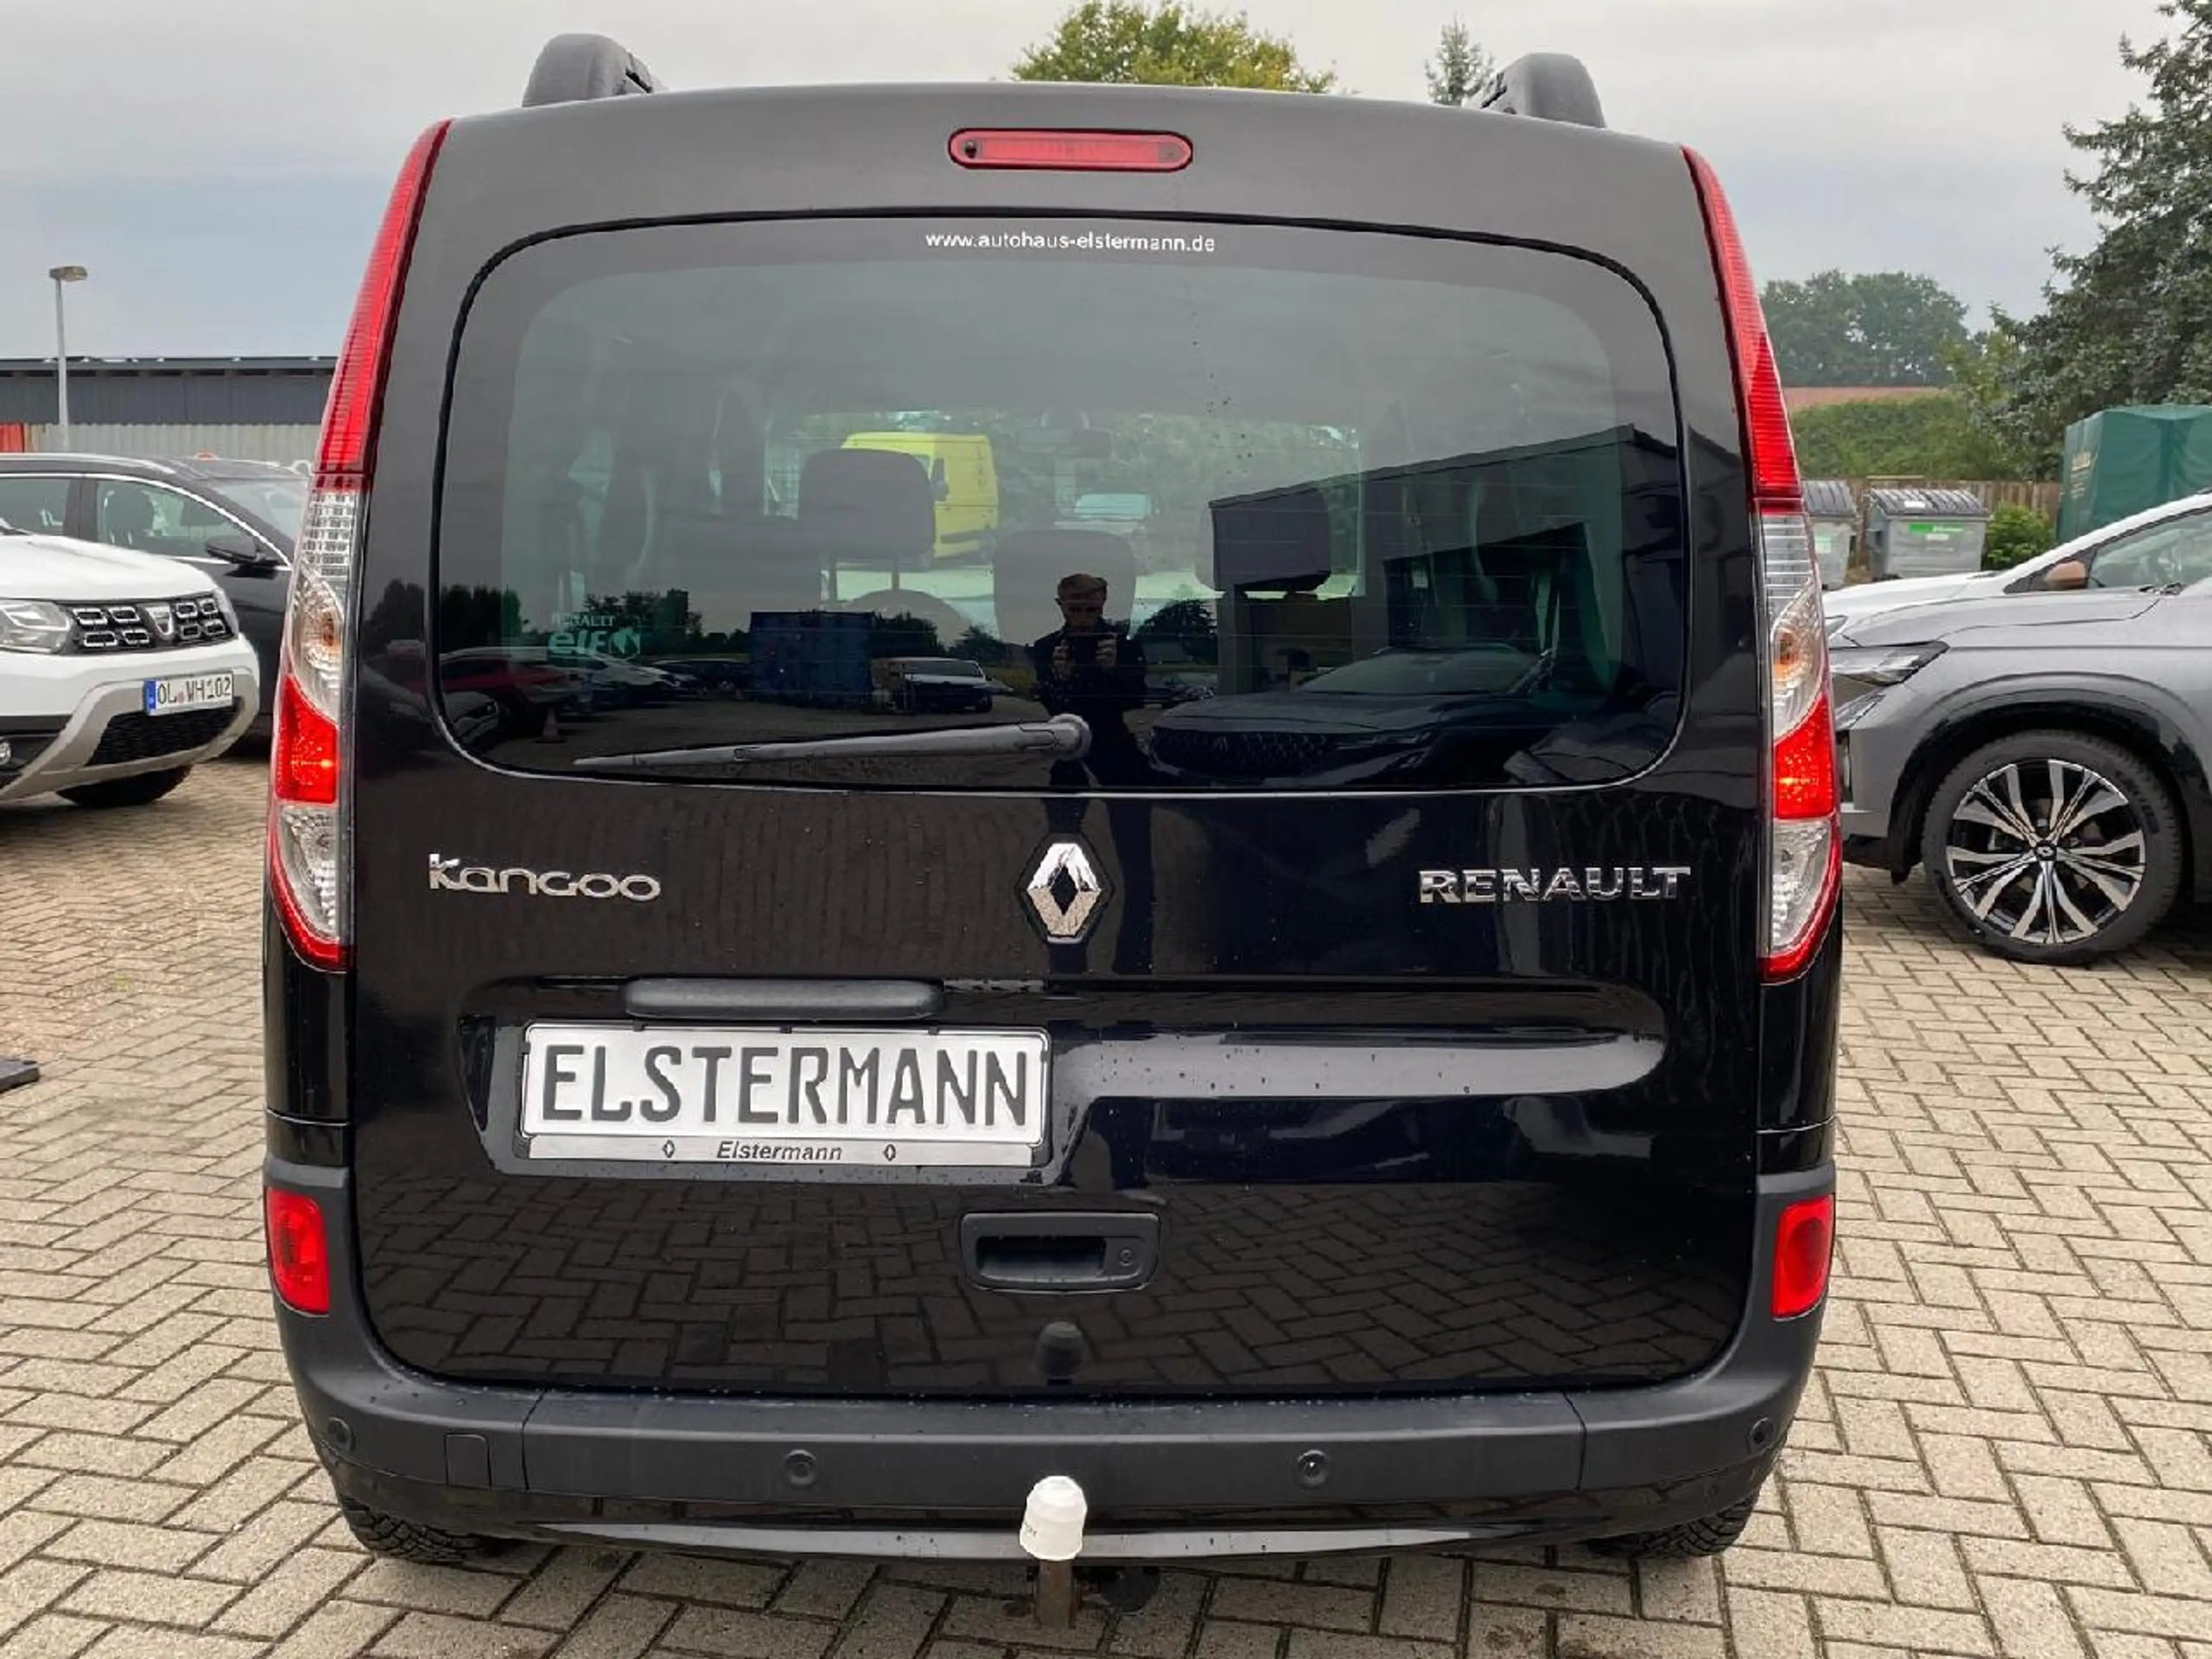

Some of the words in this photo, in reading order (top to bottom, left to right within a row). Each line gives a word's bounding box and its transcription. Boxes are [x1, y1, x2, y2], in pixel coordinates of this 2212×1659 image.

[925, 232, 1216, 252] www.autohaus-elstermann.de
[157, 682, 177, 704] OL
[1419, 865, 1692, 904] RENAULT
[541, 1043, 1028, 1127] ELSTERMANN
[715, 1141, 843, 1162] Elstermann
